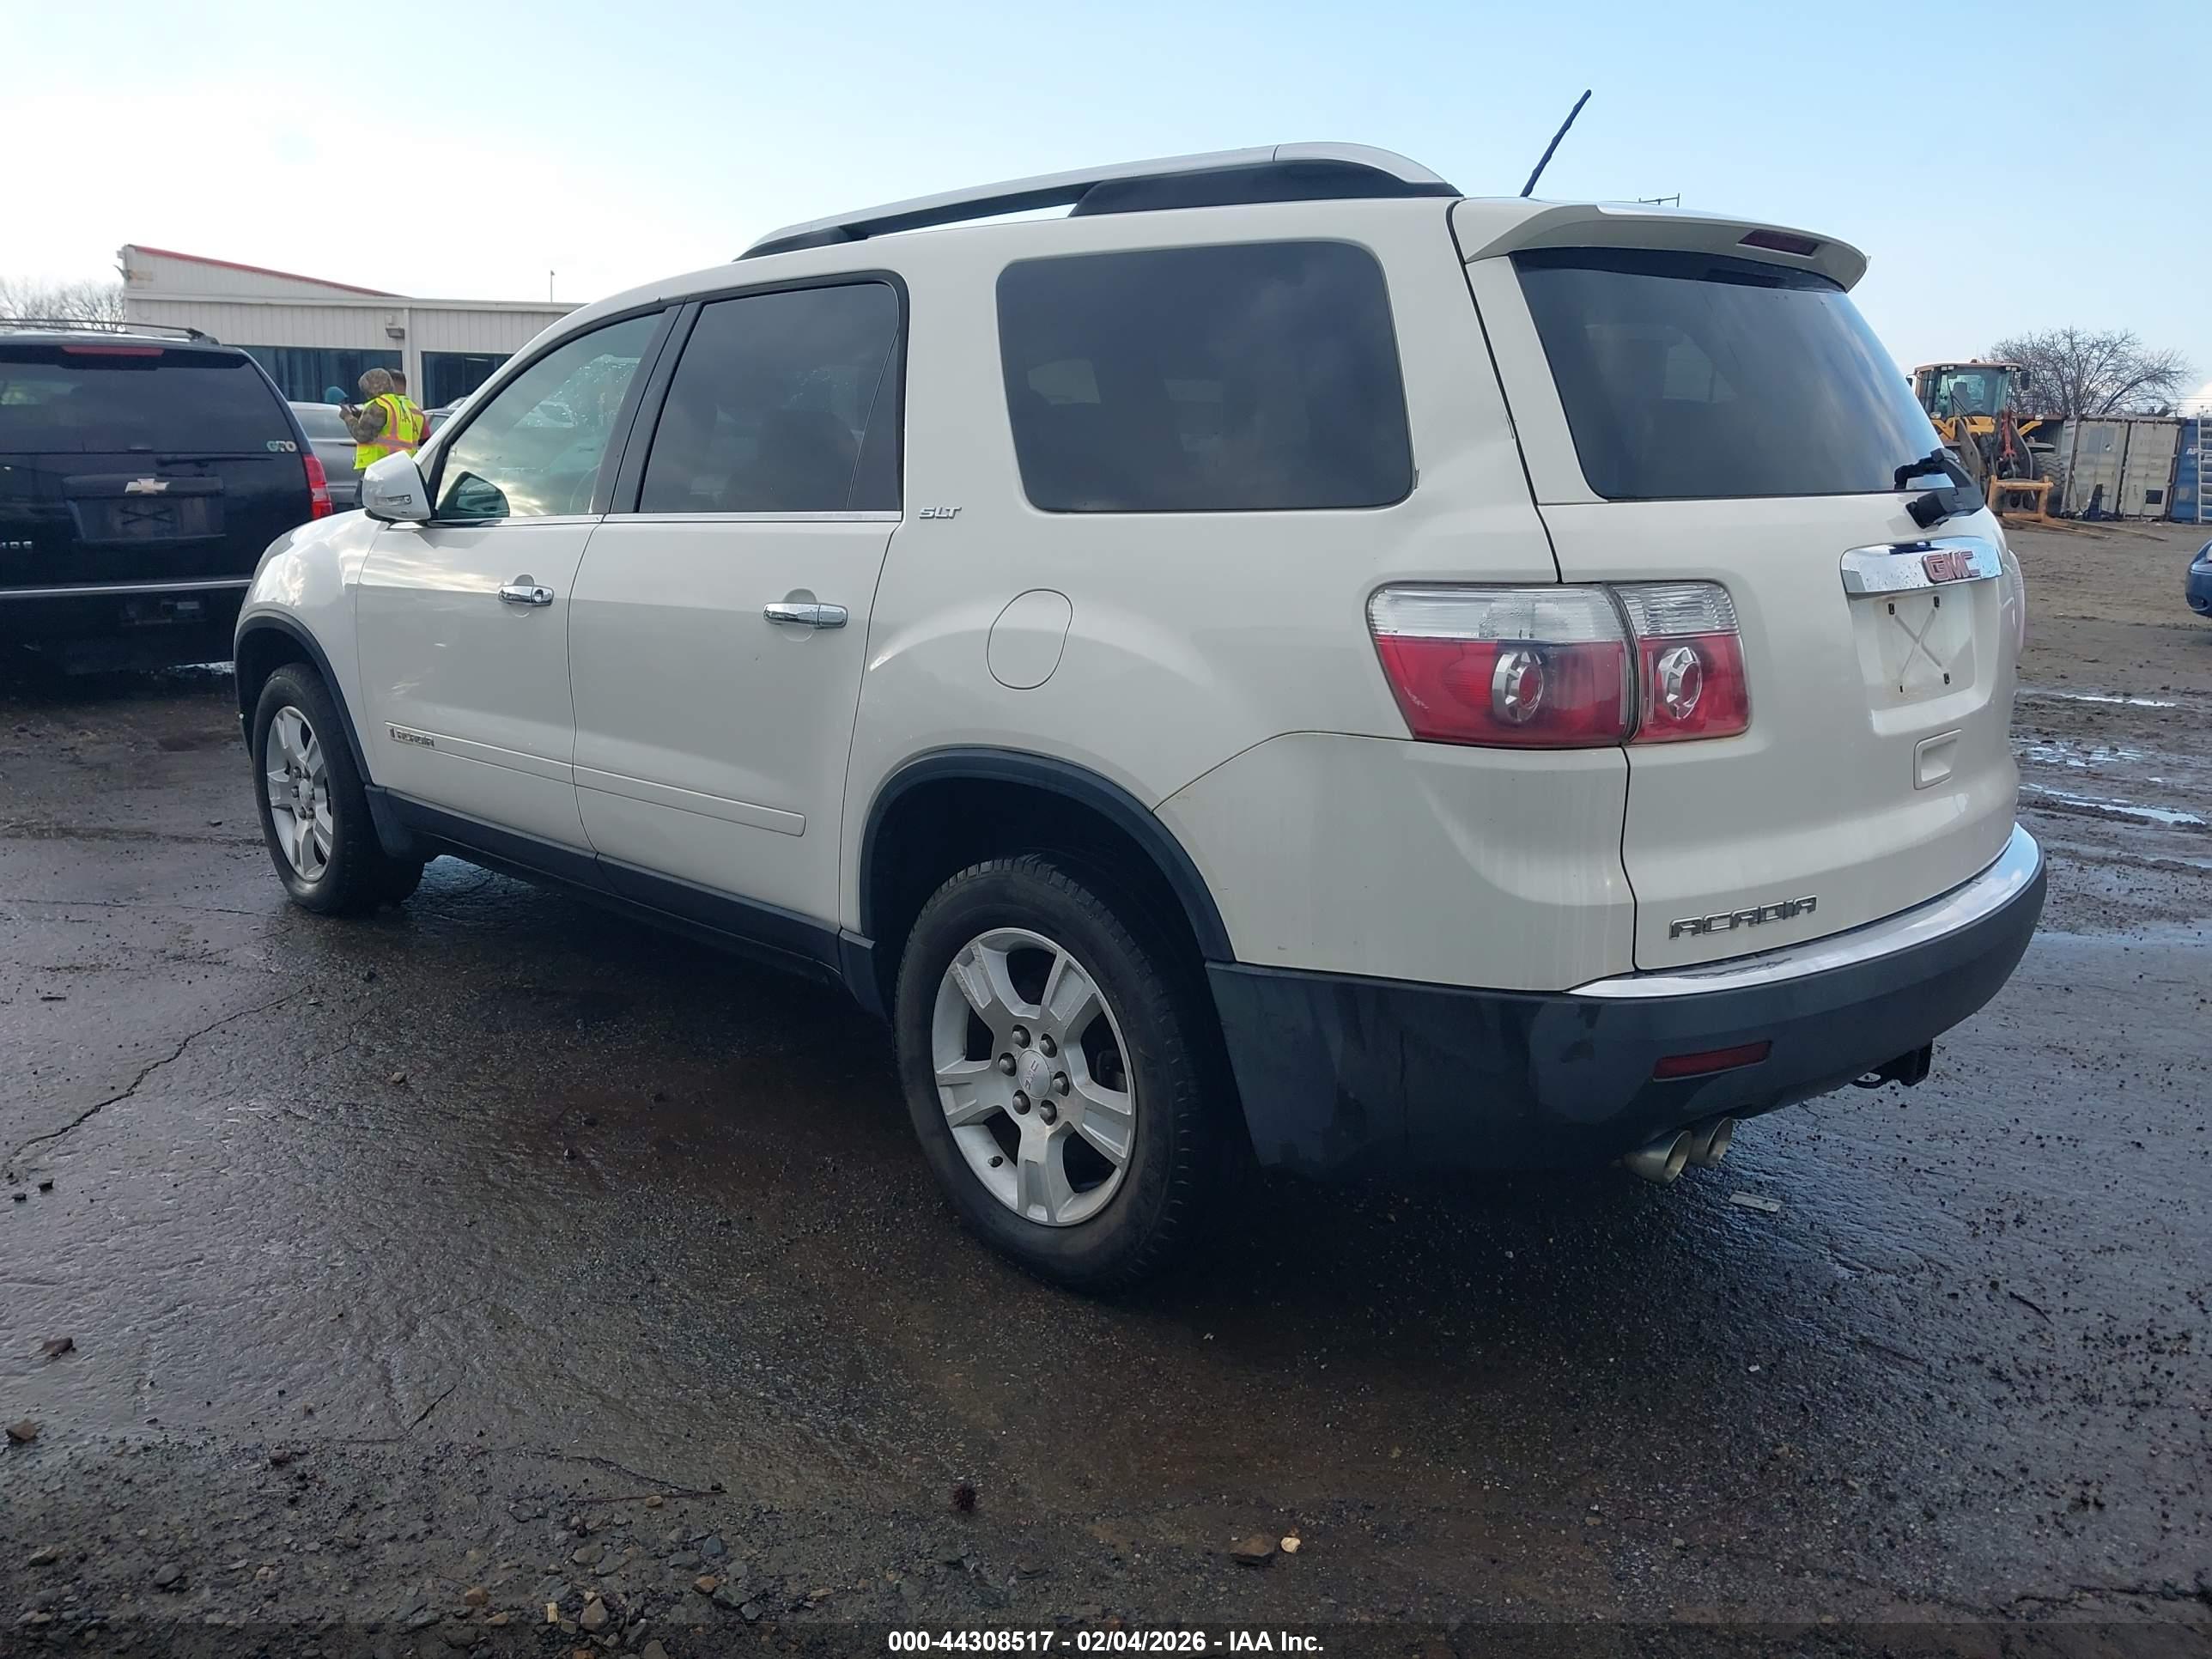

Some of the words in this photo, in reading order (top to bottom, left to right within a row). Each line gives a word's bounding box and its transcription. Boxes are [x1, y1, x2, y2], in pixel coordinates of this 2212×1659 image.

[918, 507, 963, 520] SLT
[1922, 550, 1981, 584] GMC
[1668, 894, 1818, 940] ACADIA
